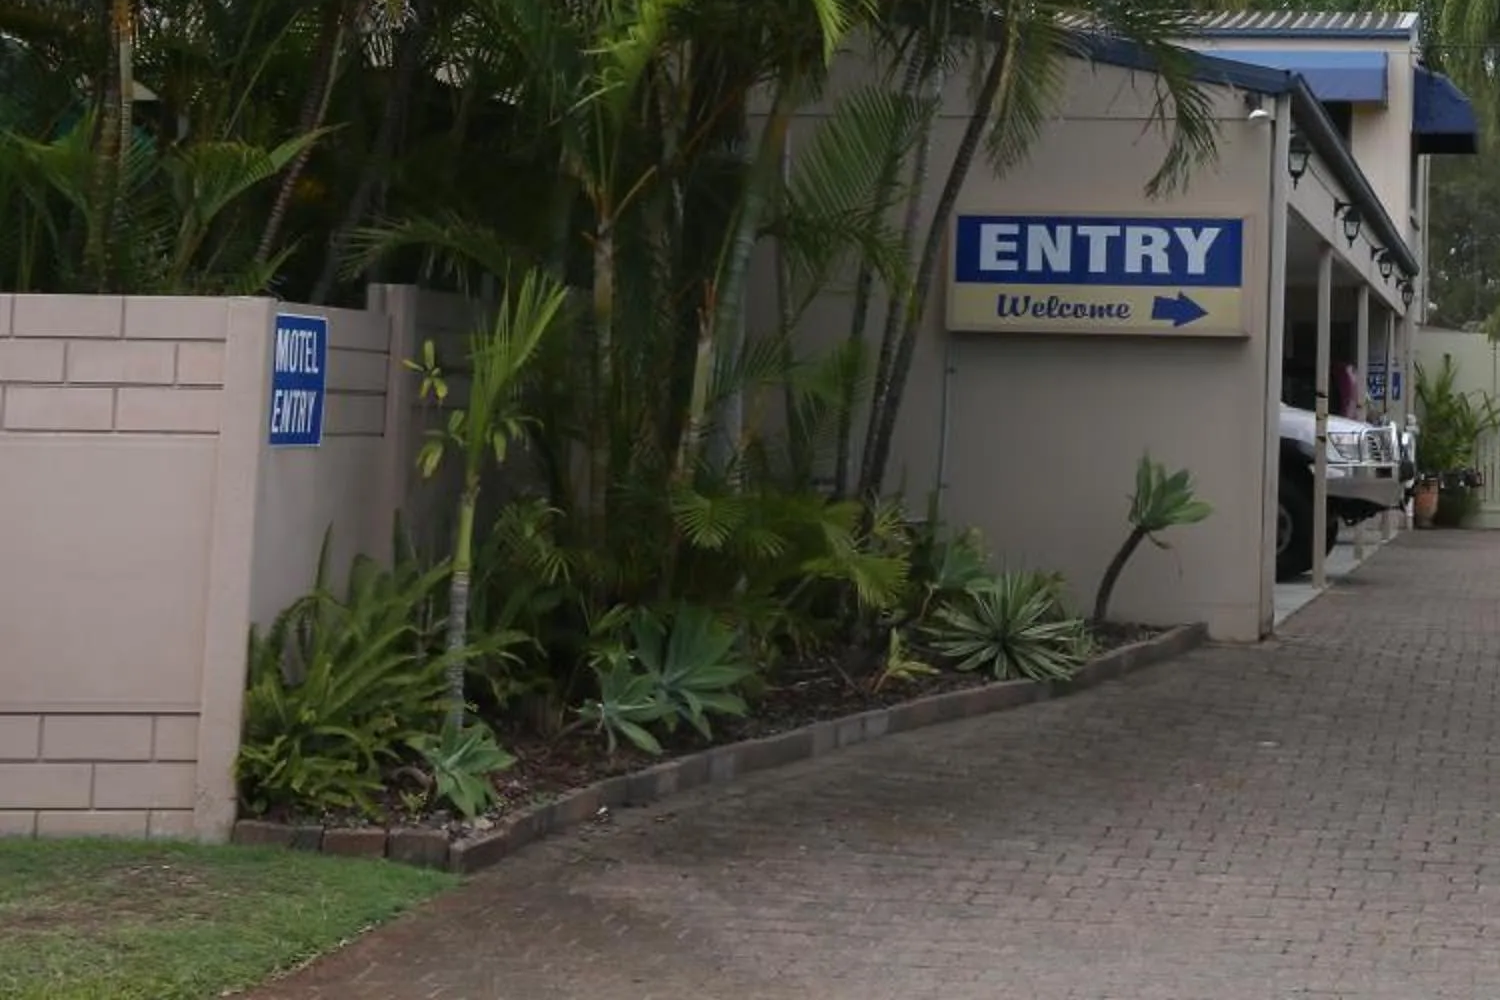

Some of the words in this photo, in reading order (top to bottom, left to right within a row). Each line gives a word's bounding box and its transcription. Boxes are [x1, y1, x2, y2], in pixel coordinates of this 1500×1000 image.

[978, 222, 1223, 275] ENTRY
[996, 293, 1133, 320] Welcome
[275, 327, 319, 374] MOTEL
[271, 388, 317, 433] ENTRY
